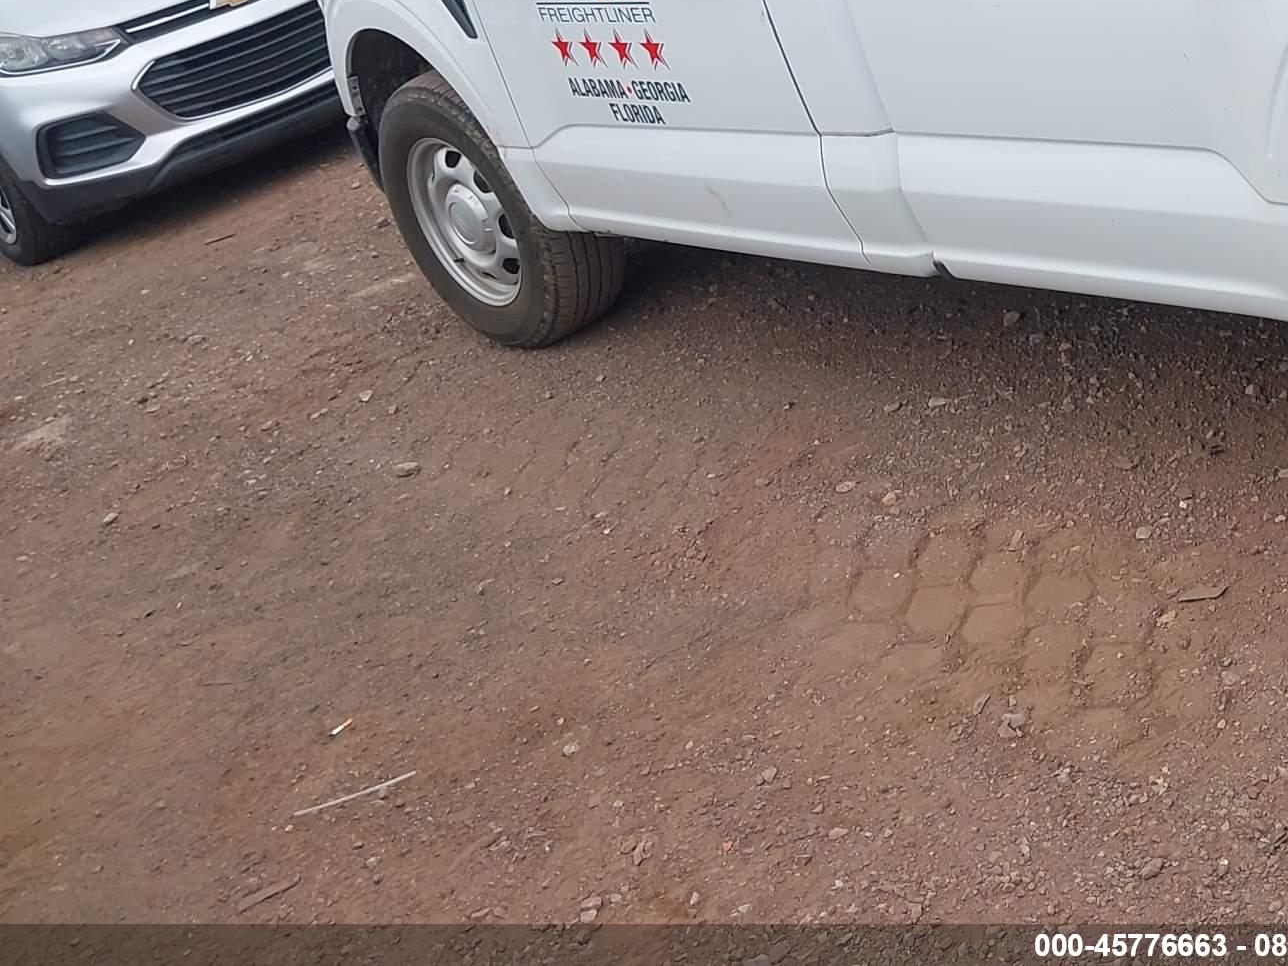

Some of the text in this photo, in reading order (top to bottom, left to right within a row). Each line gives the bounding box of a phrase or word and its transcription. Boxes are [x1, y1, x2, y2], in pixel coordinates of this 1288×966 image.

[537, 6, 657, 24] FREIGHTLINER
[568, 77, 691, 103] ALABAMA GEORGIA
[609, 103, 667, 125] FLORIDA
